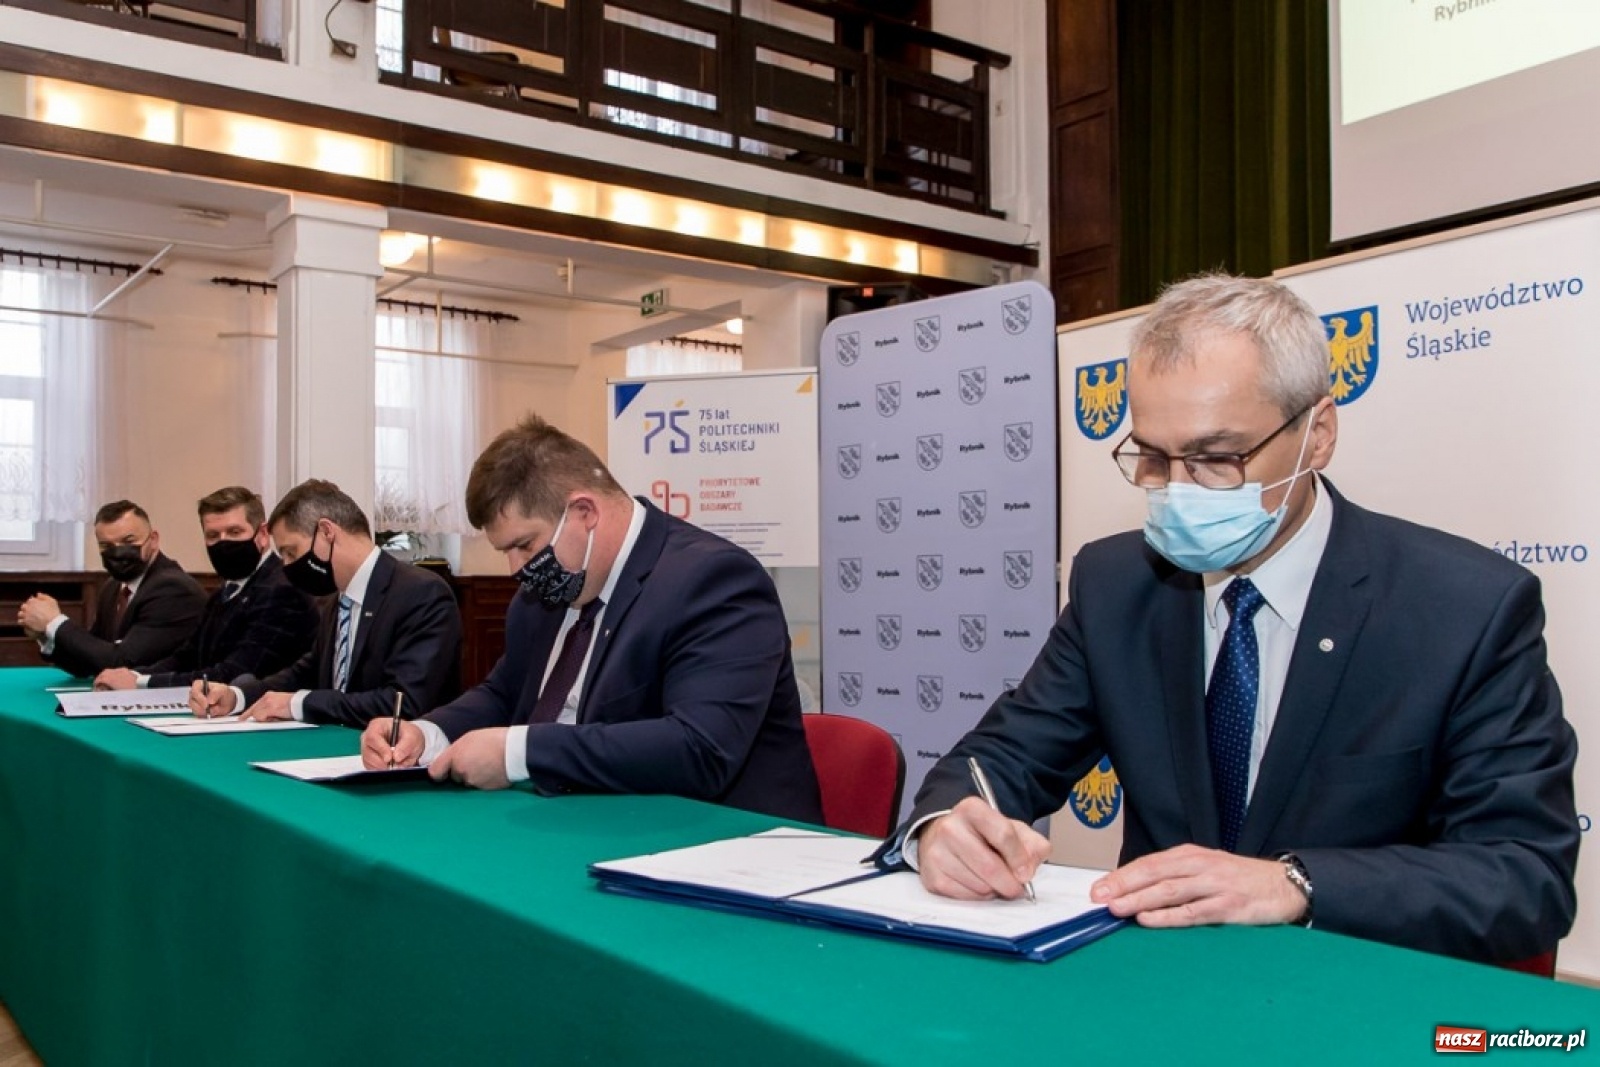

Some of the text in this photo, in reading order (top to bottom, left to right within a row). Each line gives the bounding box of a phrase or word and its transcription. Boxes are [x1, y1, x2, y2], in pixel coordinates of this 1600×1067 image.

[1405, 276, 1583, 324] Województwo
[957, 320, 984, 332] Rybnik
[875, 337, 899, 347] Rybnik
[1405, 327, 1492, 360] Śląskie
[1004, 373, 1031, 384] Rybnik
[916, 389, 941, 398] Rybnik
[838, 401, 861, 410] Rybnik
[699, 409, 730, 420] 75 lat
[699, 422, 780, 436] POLITECHNIKI
[699, 440, 755, 454] ŚLĄSKIEJ
[960, 442, 985, 453] Rybnik
[876, 453, 899, 462] Rybnik
[1004, 501, 1030, 511] Rybnik
[917, 508, 941, 517] Rybnik
[838, 515, 860, 523] Rybnik
[876, 570, 899, 578] Rybnik
[959, 567, 985, 576] Rybnik
[838, 628, 861, 636] Rybnik
[917, 629, 941, 637] Rybnik
[1004, 630, 1030, 639] Rybnik
[877, 687, 900, 695] Rybnik
[960, 692, 985, 700] Rybnik
[917, 750, 941, 759] Rybnik
